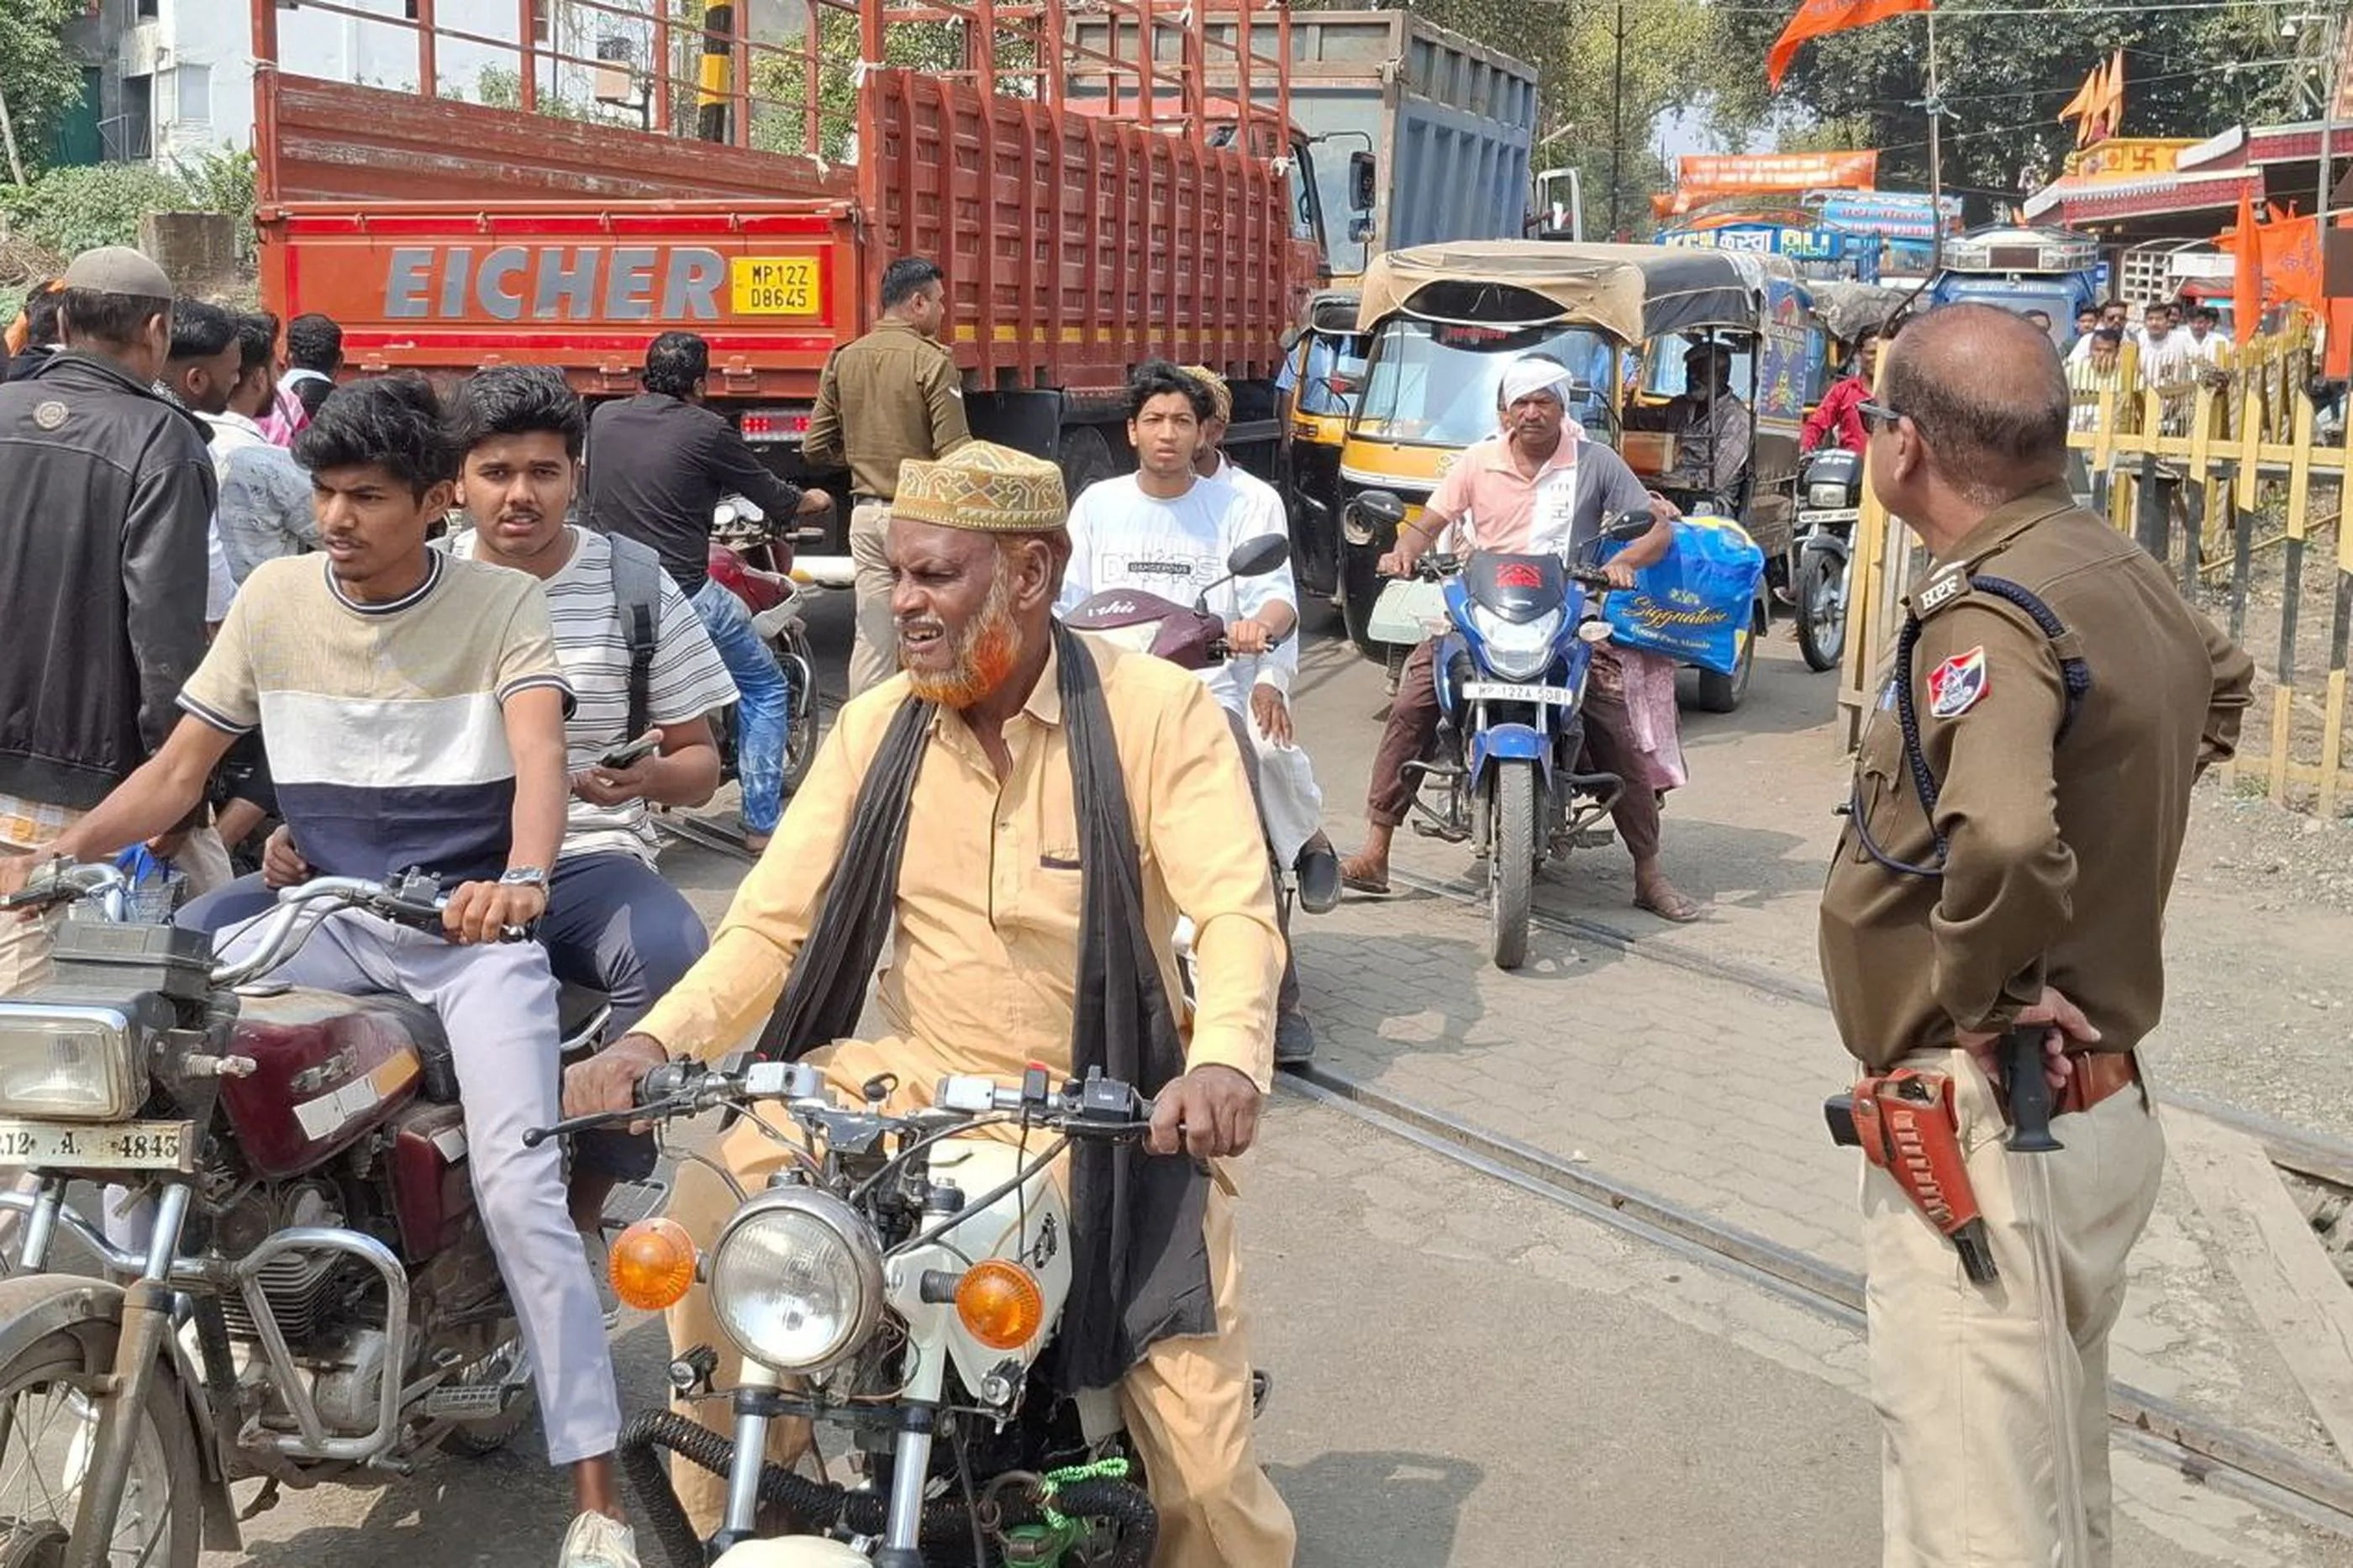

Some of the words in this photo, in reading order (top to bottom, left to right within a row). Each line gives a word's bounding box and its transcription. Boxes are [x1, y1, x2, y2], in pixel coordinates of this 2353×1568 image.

[384, 246, 725, 319] EICHER
[753, 265, 808, 285] MP12Z
[751, 288, 807, 308] D8645
